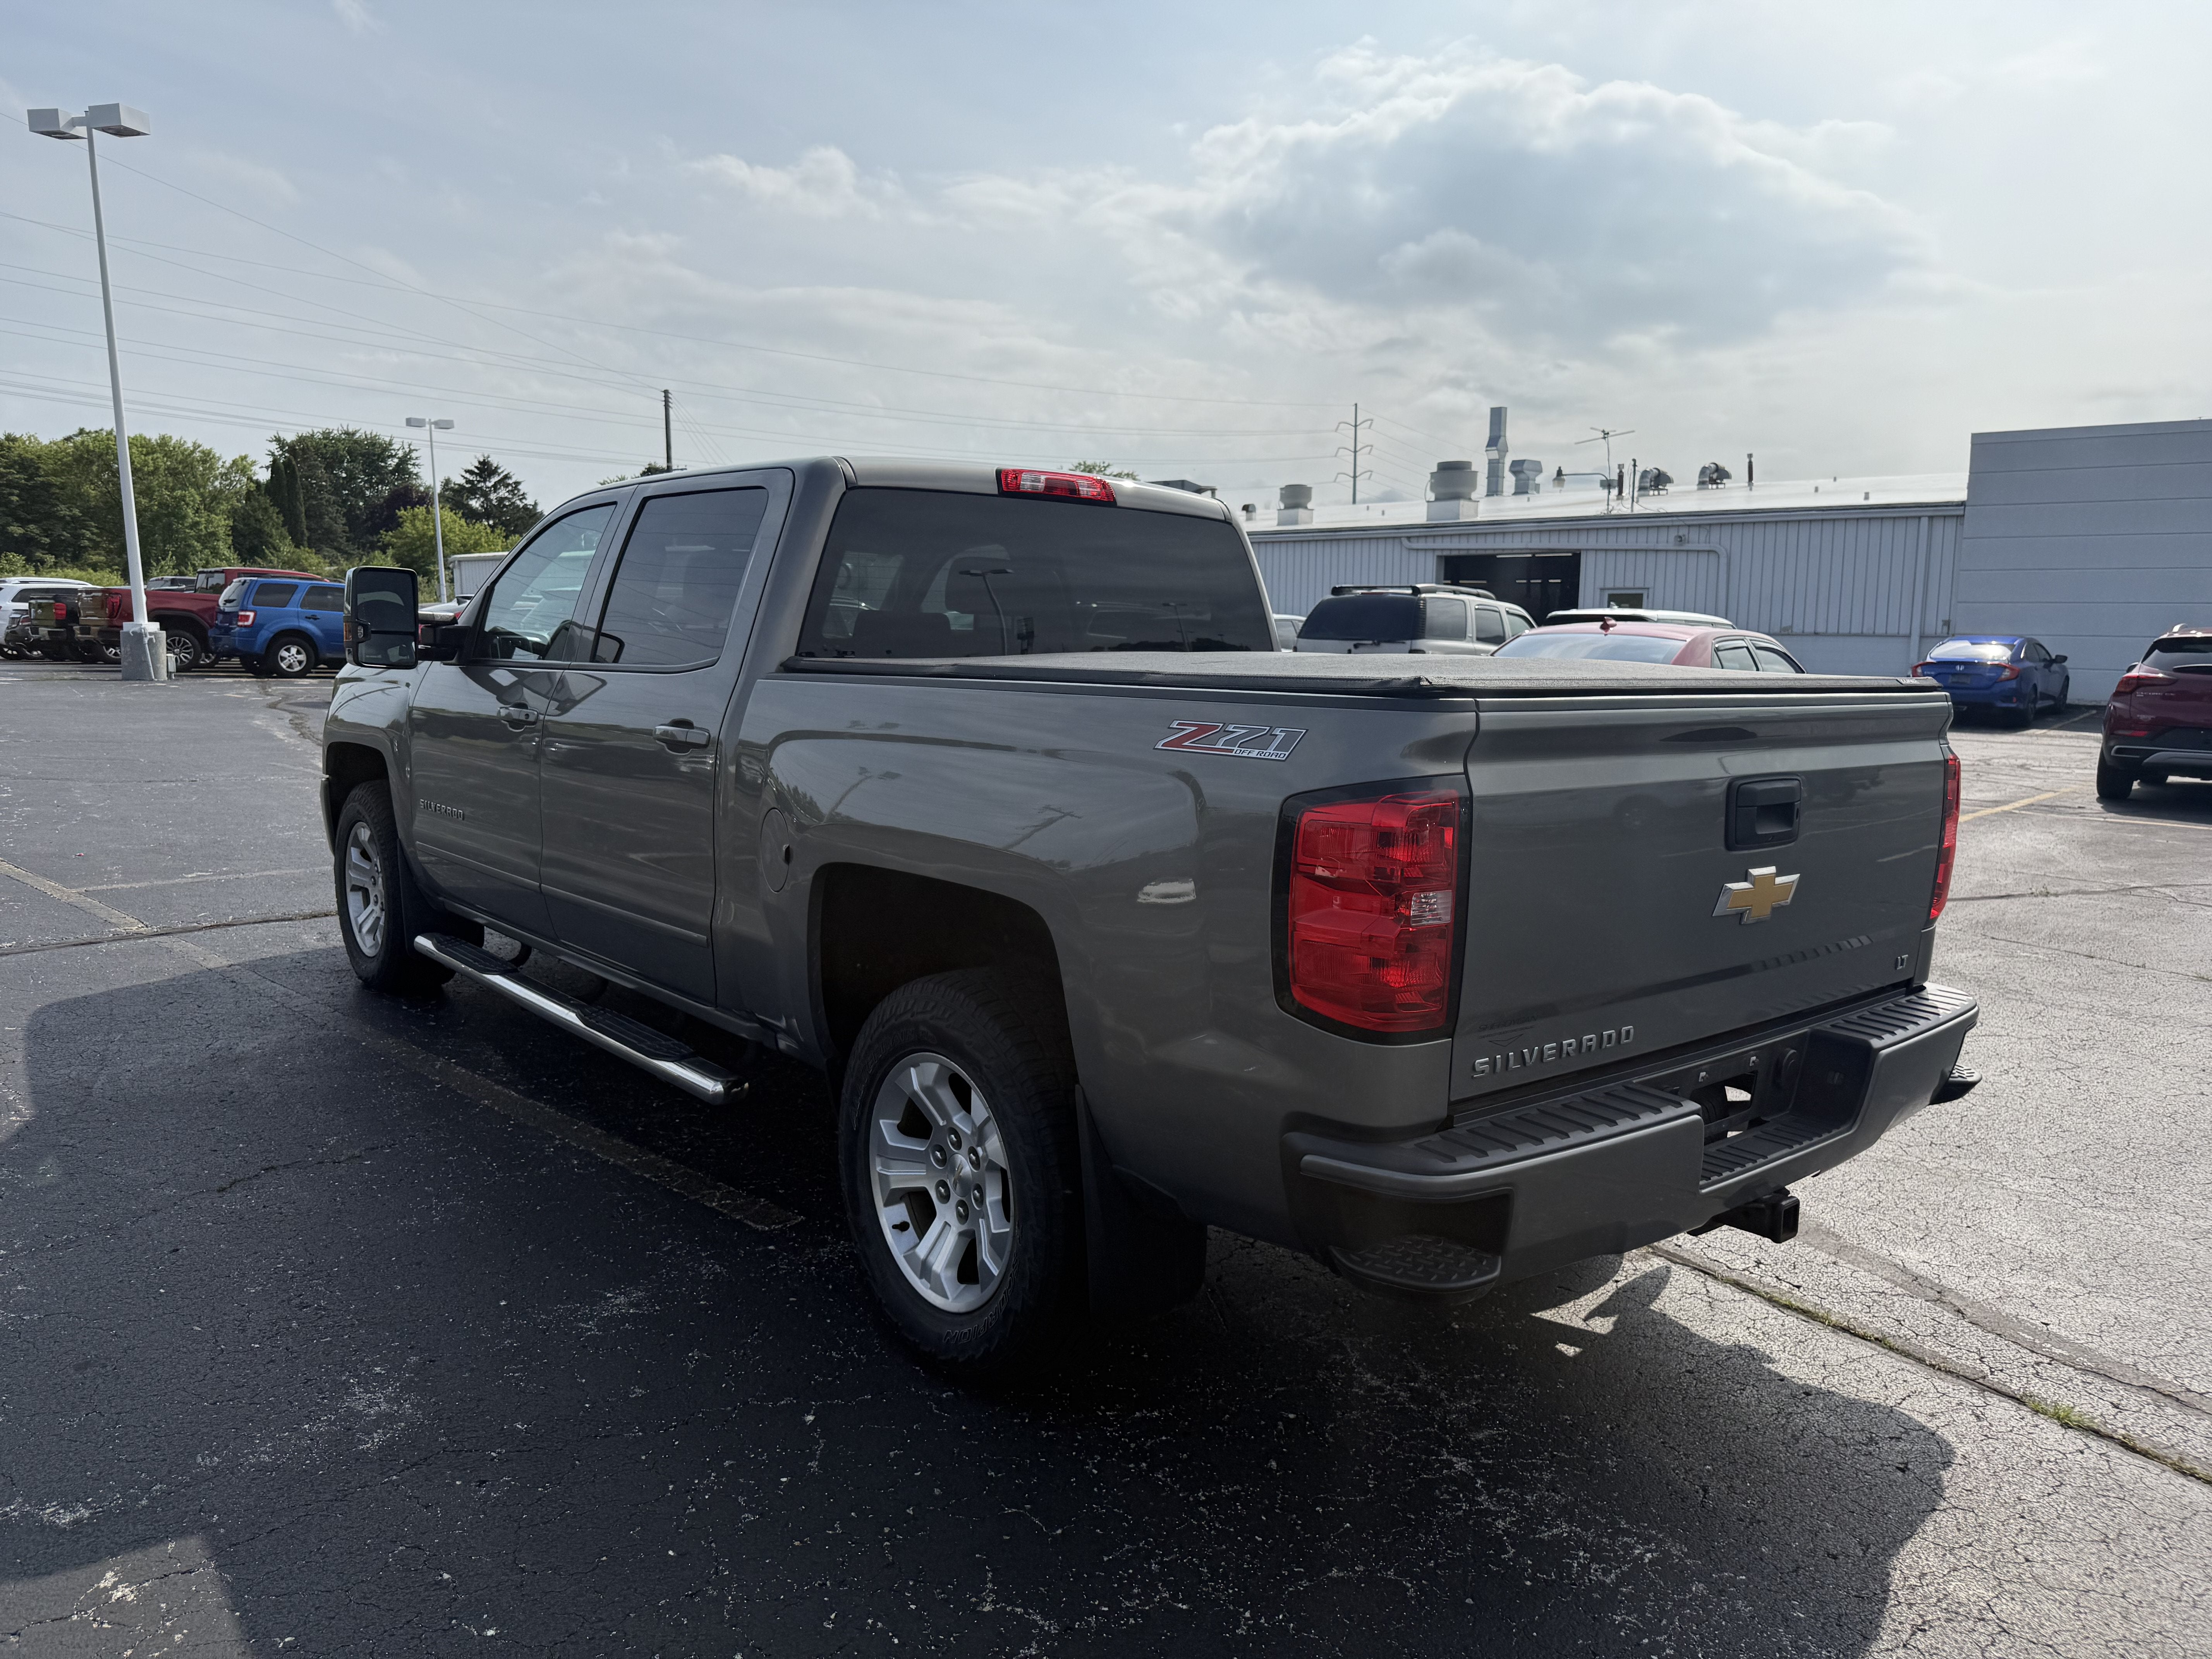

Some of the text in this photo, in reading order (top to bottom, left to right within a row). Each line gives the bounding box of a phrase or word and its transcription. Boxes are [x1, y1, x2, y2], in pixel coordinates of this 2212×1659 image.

[1154, 720, 1308, 756] Z71
[420, 799, 464, 820] SILVERADO
[1896, 954, 1908, 970] LT
[1471, 1025, 1634, 1079] SILVERADO
[943, 1250, 1020, 1344] SCORPION
